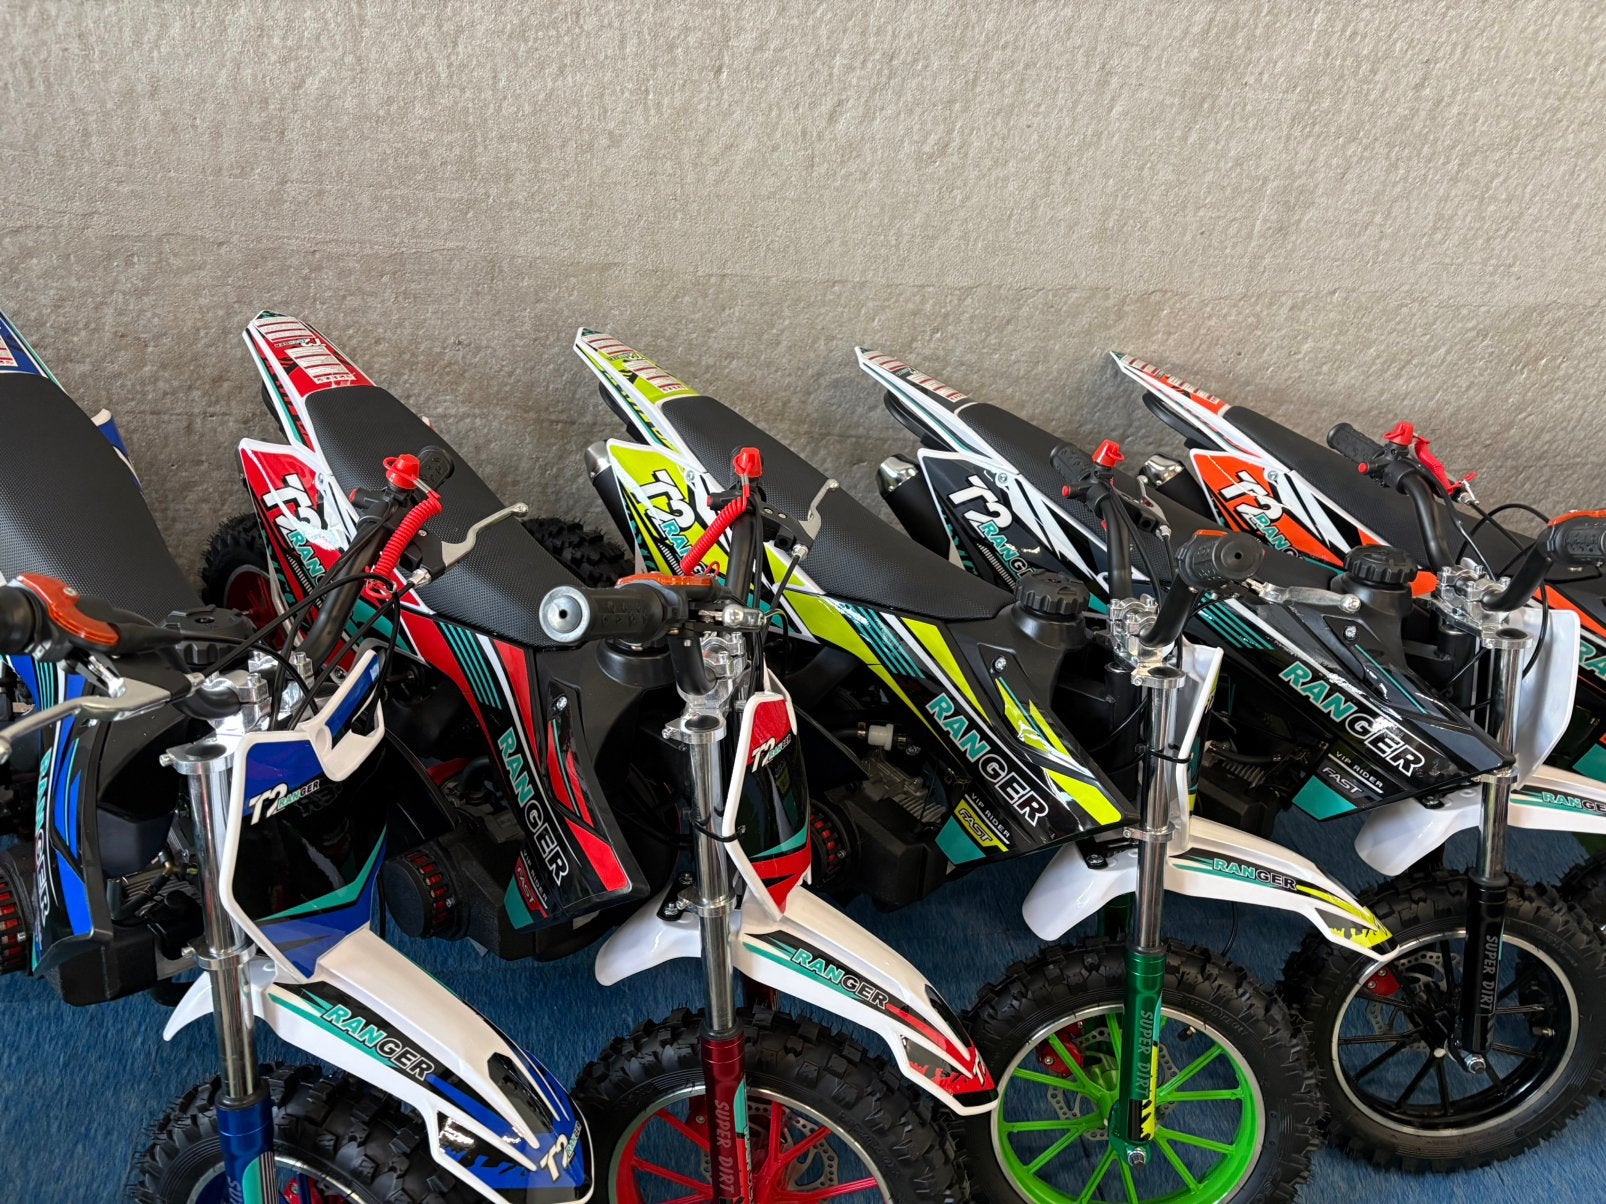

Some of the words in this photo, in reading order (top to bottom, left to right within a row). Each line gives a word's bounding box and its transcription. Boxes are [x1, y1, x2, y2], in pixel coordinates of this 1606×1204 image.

[262, 474, 323, 541] T2
[638, 468, 696, 529] T2
[949, 475, 1013, 537] T2
[1219, 470, 1283, 529] T2
[1278, 660, 1427, 778] RANGER
[925, 692, 1049, 827] RANGER
[1321, 766, 1365, 795] FAST
[1334, 751, 1351, 764] VIP
[1352, 762, 1384, 789] RIDER
[249, 783, 290, 826] T2
[277, 780, 320, 811] RANGER
[498, 727, 569, 886] RANGER
[970, 792, 985, 808] VIP
[984, 809, 1011, 839] RIDER
[35, 747, 53, 926] RANGER
[957, 808, 993, 843] FAST
[516, 866, 536, 904] FAST
[1213, 857, 1298, 891] RANGER
[1482, 935, 1498, 974] SUPER
[791, 947, 889, 1010] RANGER
[1480, 979, 1495, 1012] DIRT
[321, 1004, 435, 1081] RANGER
[1138, 1010, 1153, 1057] SUPER
[1135, 1062, 1151, 1097] DIRT
[714, 1099, 732, 1150] SUPER
[540, 1134, 568, 1181] T2
[718, 1152, 734, 1194] DIRT
